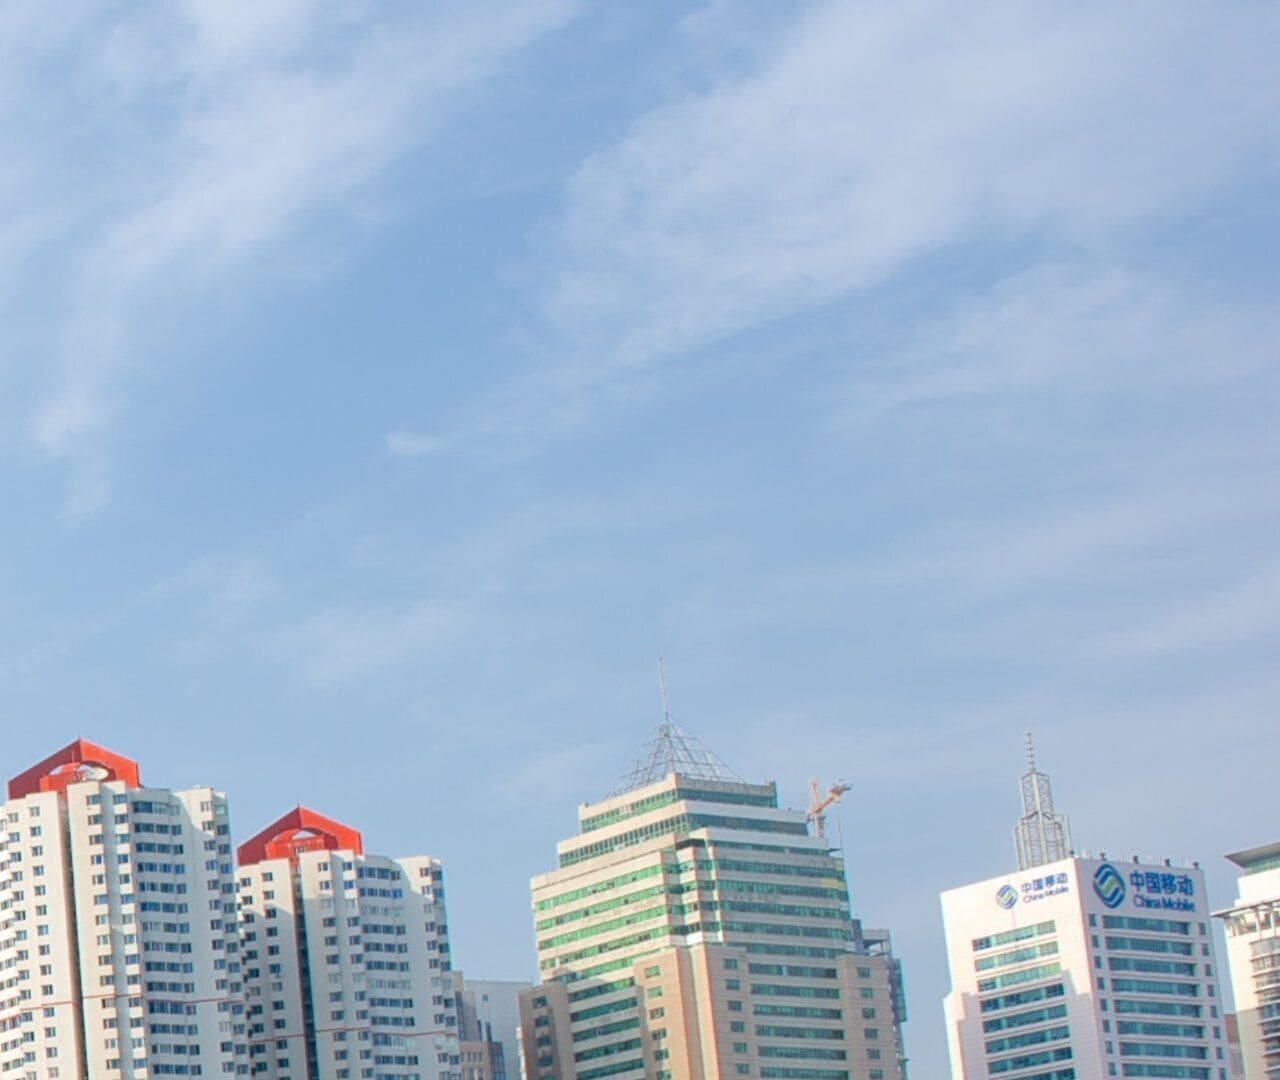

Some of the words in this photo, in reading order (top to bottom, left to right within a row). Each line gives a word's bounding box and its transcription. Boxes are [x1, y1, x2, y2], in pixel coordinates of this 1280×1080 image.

[1021, 872, 1068, 894] 中国移动
[1130, 870, 1194, 895] 中国移动
[1133, 894, 1160, 909] China
[1161, 897, 1195, 912] Mobile
